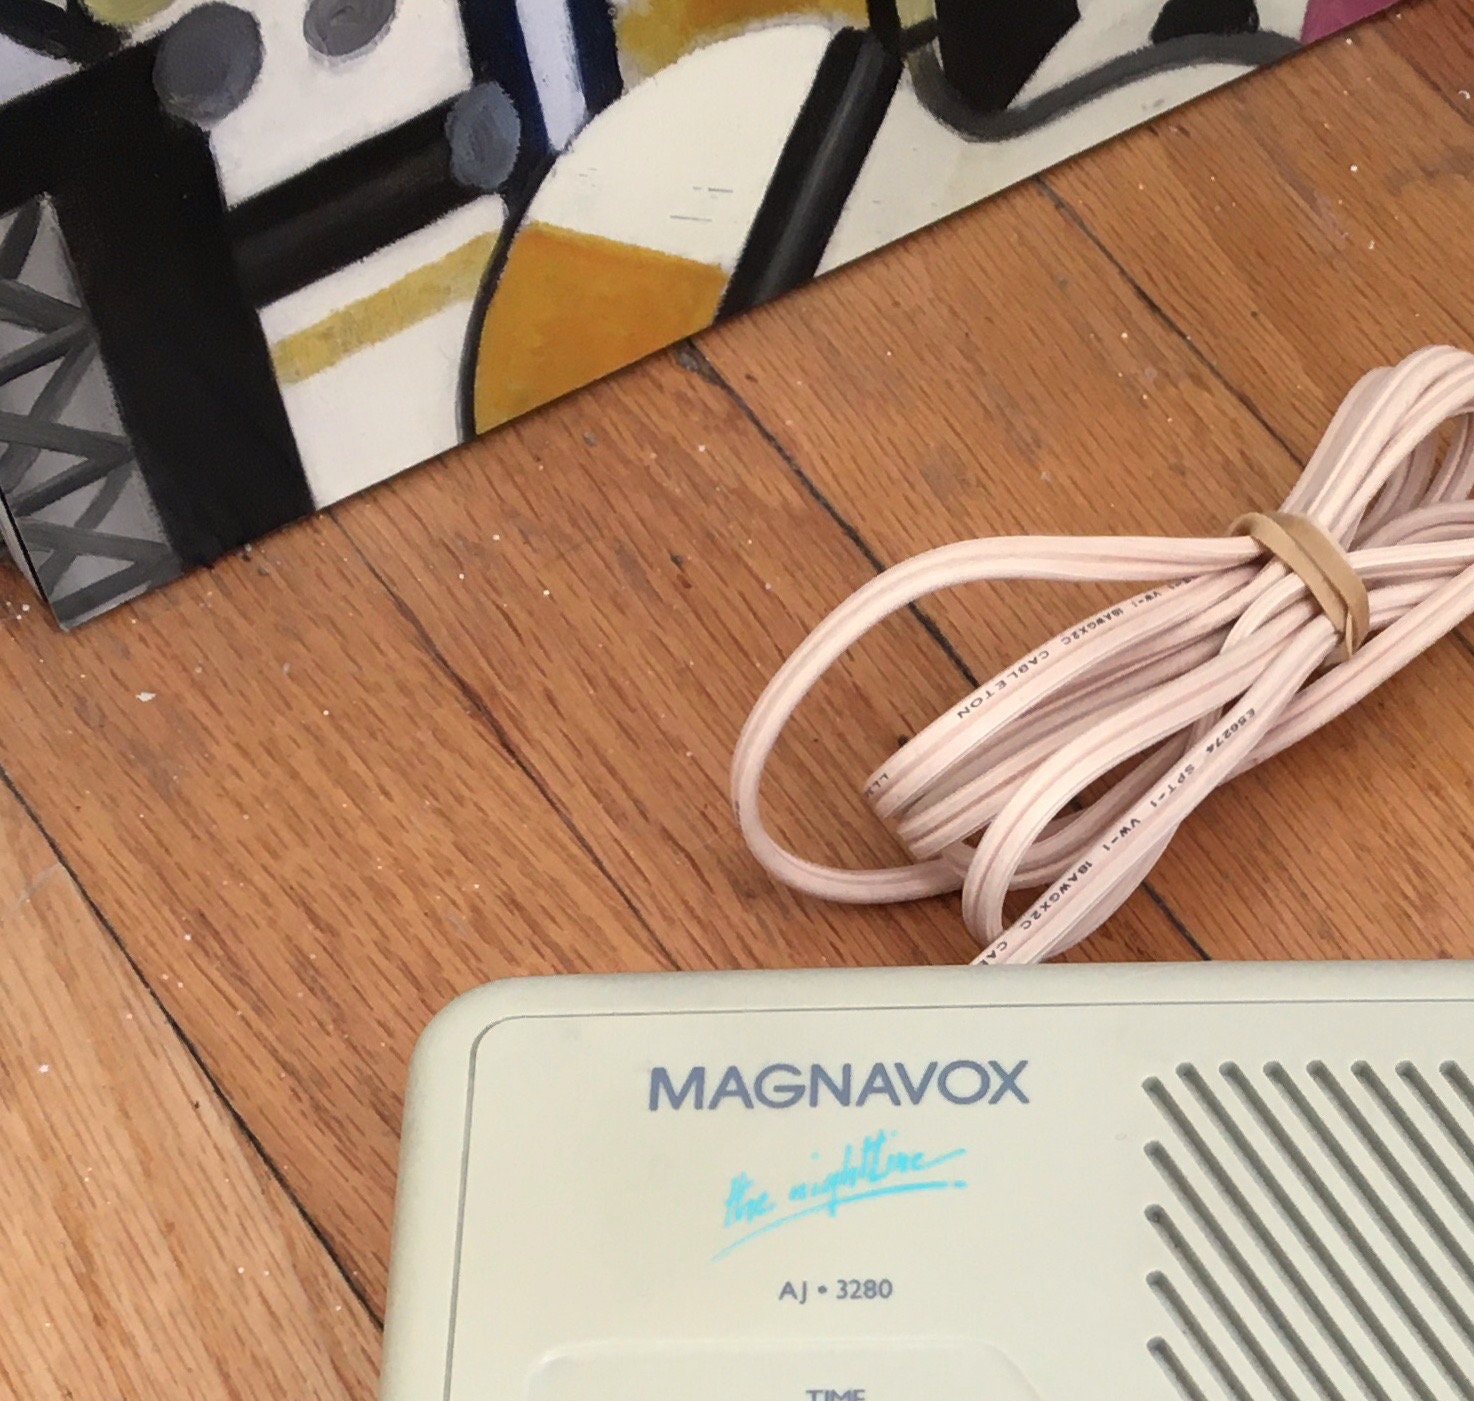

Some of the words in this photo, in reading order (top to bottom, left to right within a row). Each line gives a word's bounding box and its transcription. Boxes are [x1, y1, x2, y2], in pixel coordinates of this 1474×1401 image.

[956, 649, 1050, 720] CABLETON
[1149, 763, 1196, 809] SPT-1
[1101, 817, 1142, 852] VW-1
[1020, 860, 1094, 931] 18AWGX2C
[648, 1059, 1030, 1111] MAGNAVOX
[778, 1279, 808, 1304] AJ
[836, 1278, 893, 1300] 3280
